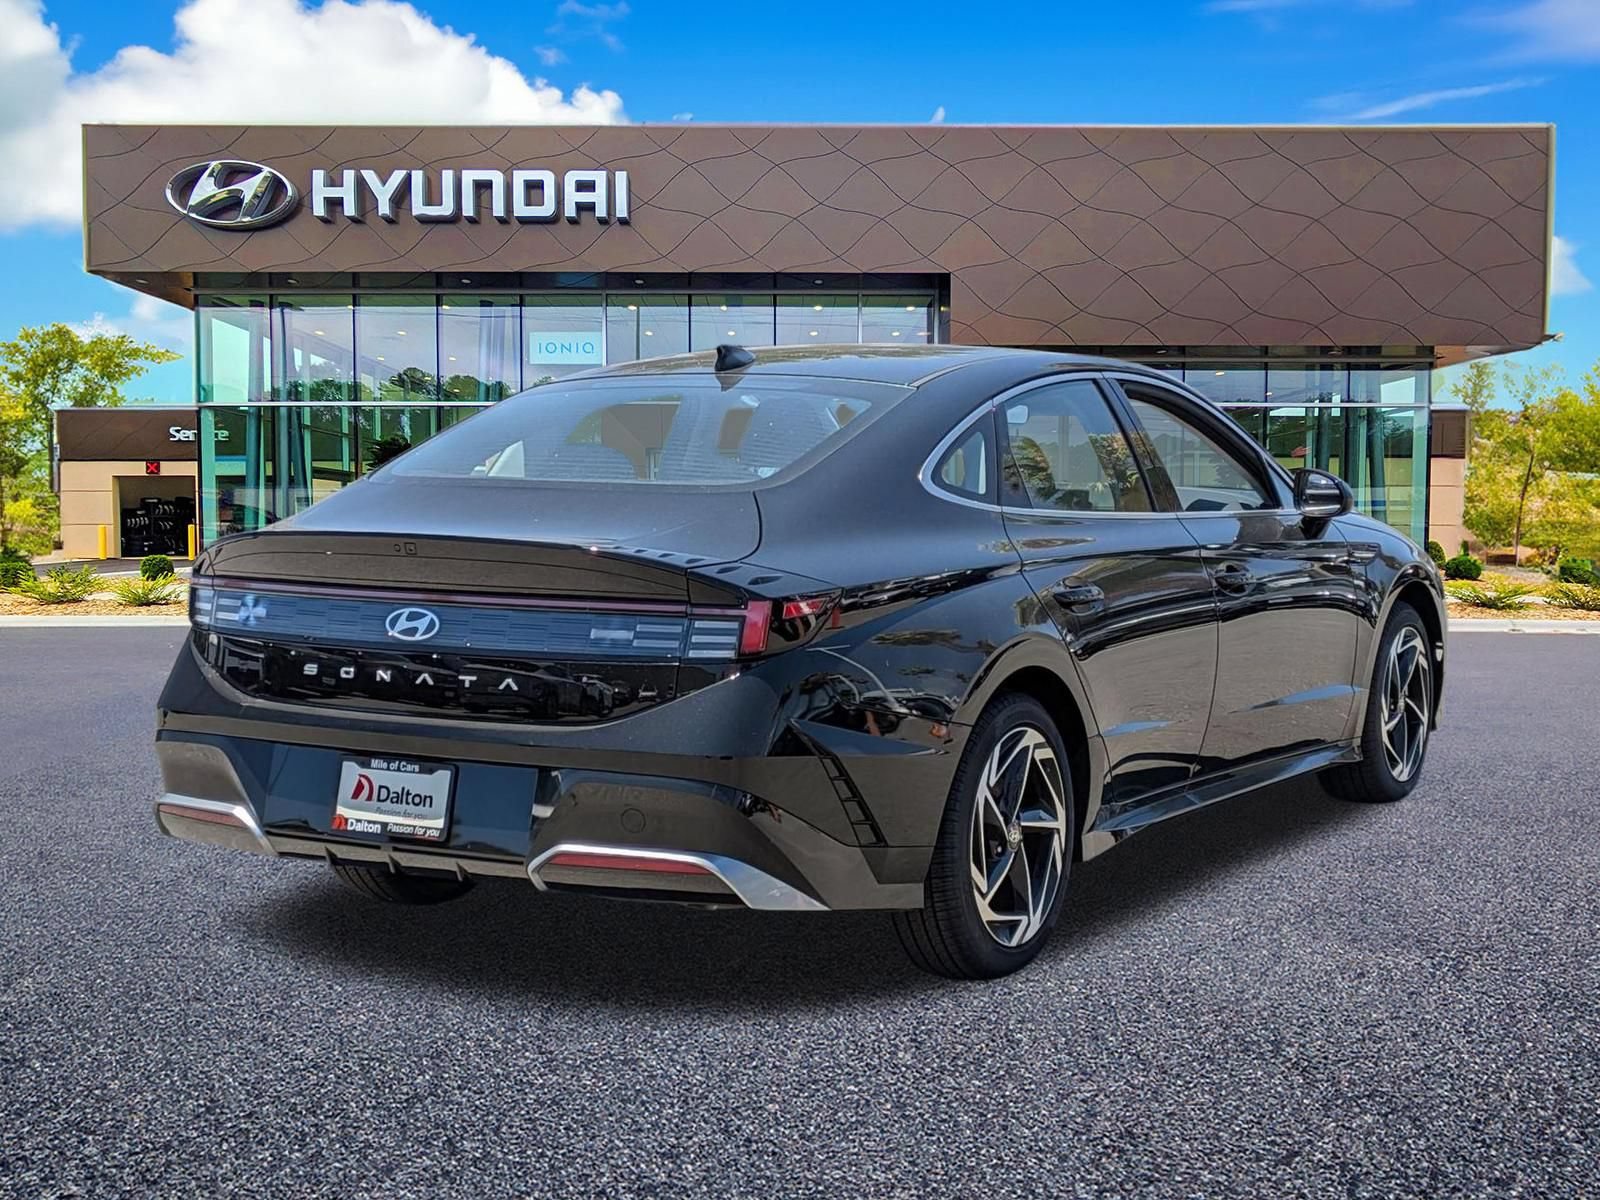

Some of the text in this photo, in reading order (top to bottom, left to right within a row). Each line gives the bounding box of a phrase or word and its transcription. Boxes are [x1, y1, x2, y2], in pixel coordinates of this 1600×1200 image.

[311, 168, 631, 221] HYUNDAI
[538, 341, 595, 354] IONIQ
[169, 426, 229, 441] Sere
[303, 663, 519, 691] SONATA
[370, 759, 420, 773] Mile of Cars
[376, 784, 433, 809] Dalton
[346, 818, 381, 834] Dalton
[387, 822, 441, 838] Passion for you
